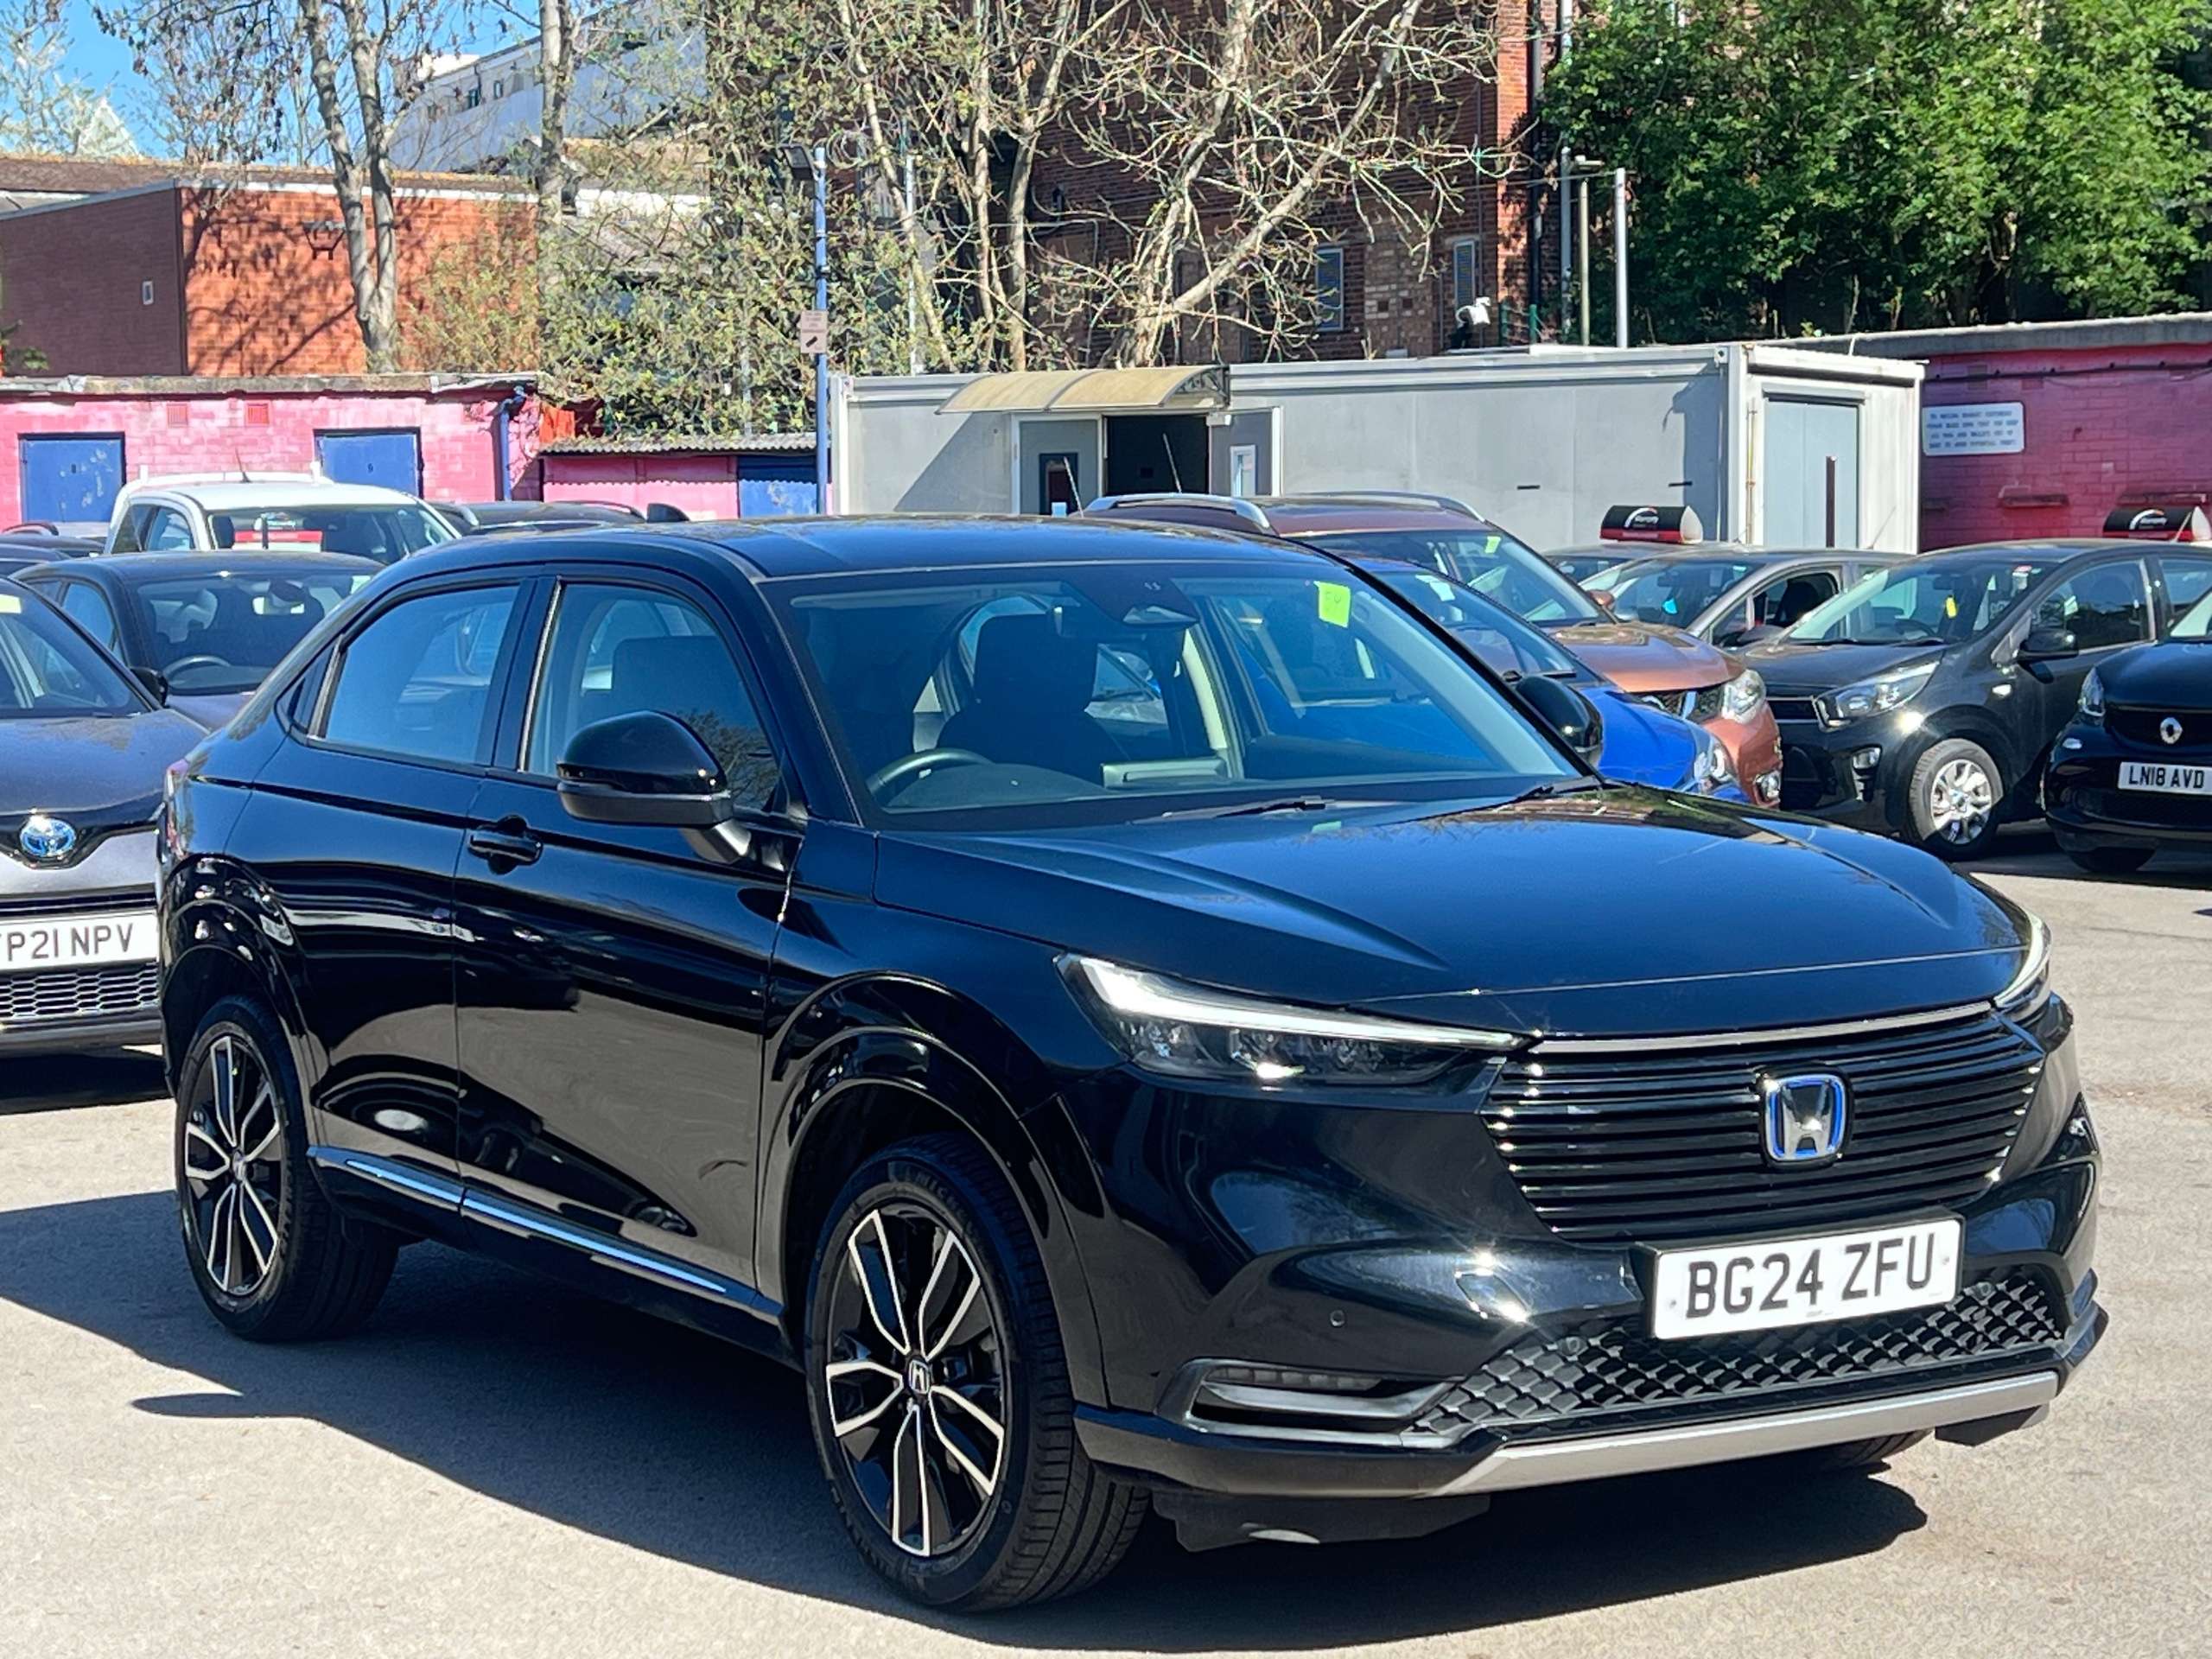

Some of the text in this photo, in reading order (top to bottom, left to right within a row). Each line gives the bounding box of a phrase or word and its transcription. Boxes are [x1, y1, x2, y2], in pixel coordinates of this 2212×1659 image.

[2128, 766, 2205, 788] LN18 AVD
[0, 923, 133, 962] P21 NPV
[1686, 1232, 1935, 1319] BG24 ZFU
